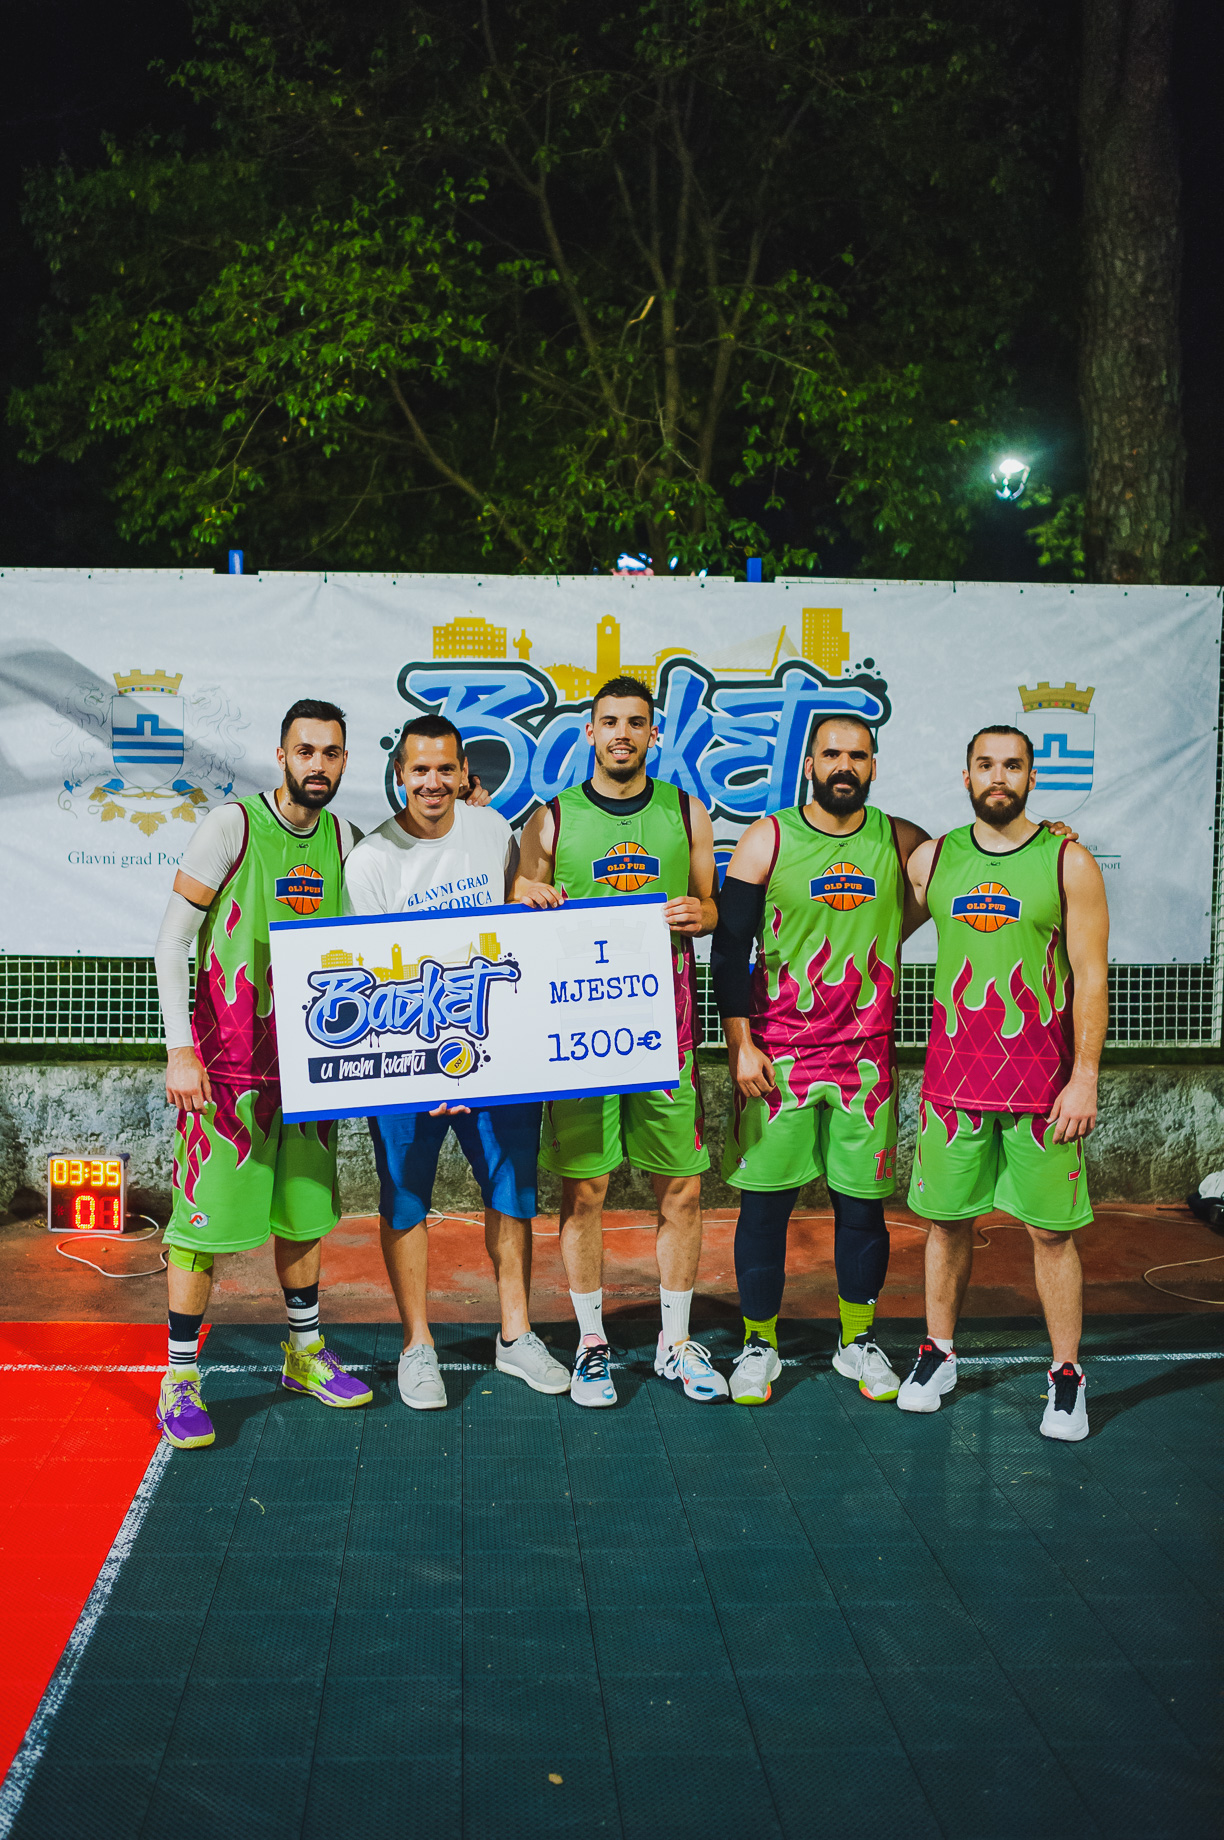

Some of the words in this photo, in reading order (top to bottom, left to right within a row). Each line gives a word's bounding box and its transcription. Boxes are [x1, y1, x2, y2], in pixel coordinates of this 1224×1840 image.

[67, 850, 116, 865] Glavni
[120, 852, 152, 869] grad
[606, 863, 626, 872] OLD
[627, 862, 646, 871] PUB
[1100, 861, 1121, 872] port
[288, 885, 304, 893] OLD
[407, 882, 454, 907] GLAVNI
[456, 873, 489, 892] GRAD
[824, 882, 843, 891] OLD
[843, 882, 863, 891] PUB
[966, 902, 987, 910] OLD
[988, 903, 1006, 911] PUB
[593, 940, 610, 965] I
[549, 973, 659, 1005] MJESTO
[547, 1027, 662, 1062] 1300€
[339, 1057, 375, 1080] mom
[380, 1050, 426, 1078] kvartu
[52, 1158, 121, 1187] 03:35
[75, 1194, 119, 1230] 01
